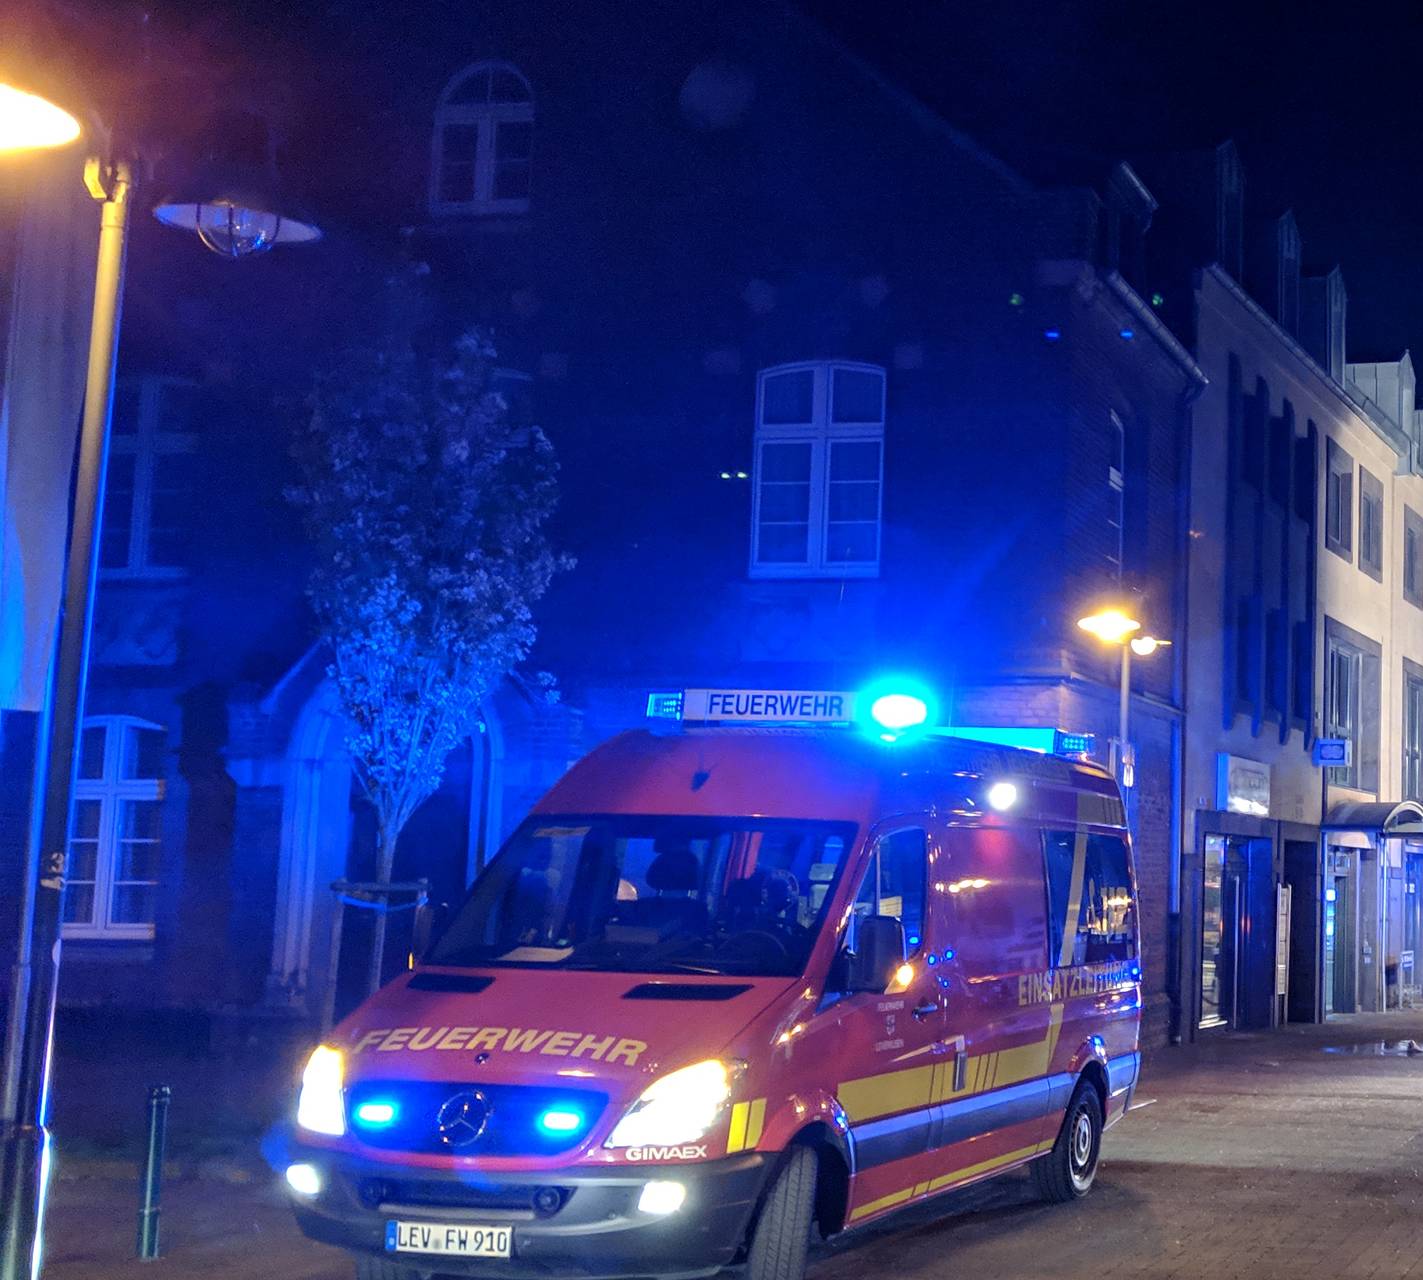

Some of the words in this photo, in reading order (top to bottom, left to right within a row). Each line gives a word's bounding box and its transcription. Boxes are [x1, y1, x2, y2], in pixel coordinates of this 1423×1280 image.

[708, 693, 844, 717] FEUERWEHR
[352, 1026, 649, 1067] FEUERWEHR
[625, 1145, 708, 1161] GIMAEX
[398, 1226, 431, 1248] LEV
[445, 1229, 468, 1250] FW
[474, 1230, 507, 1252] 910
